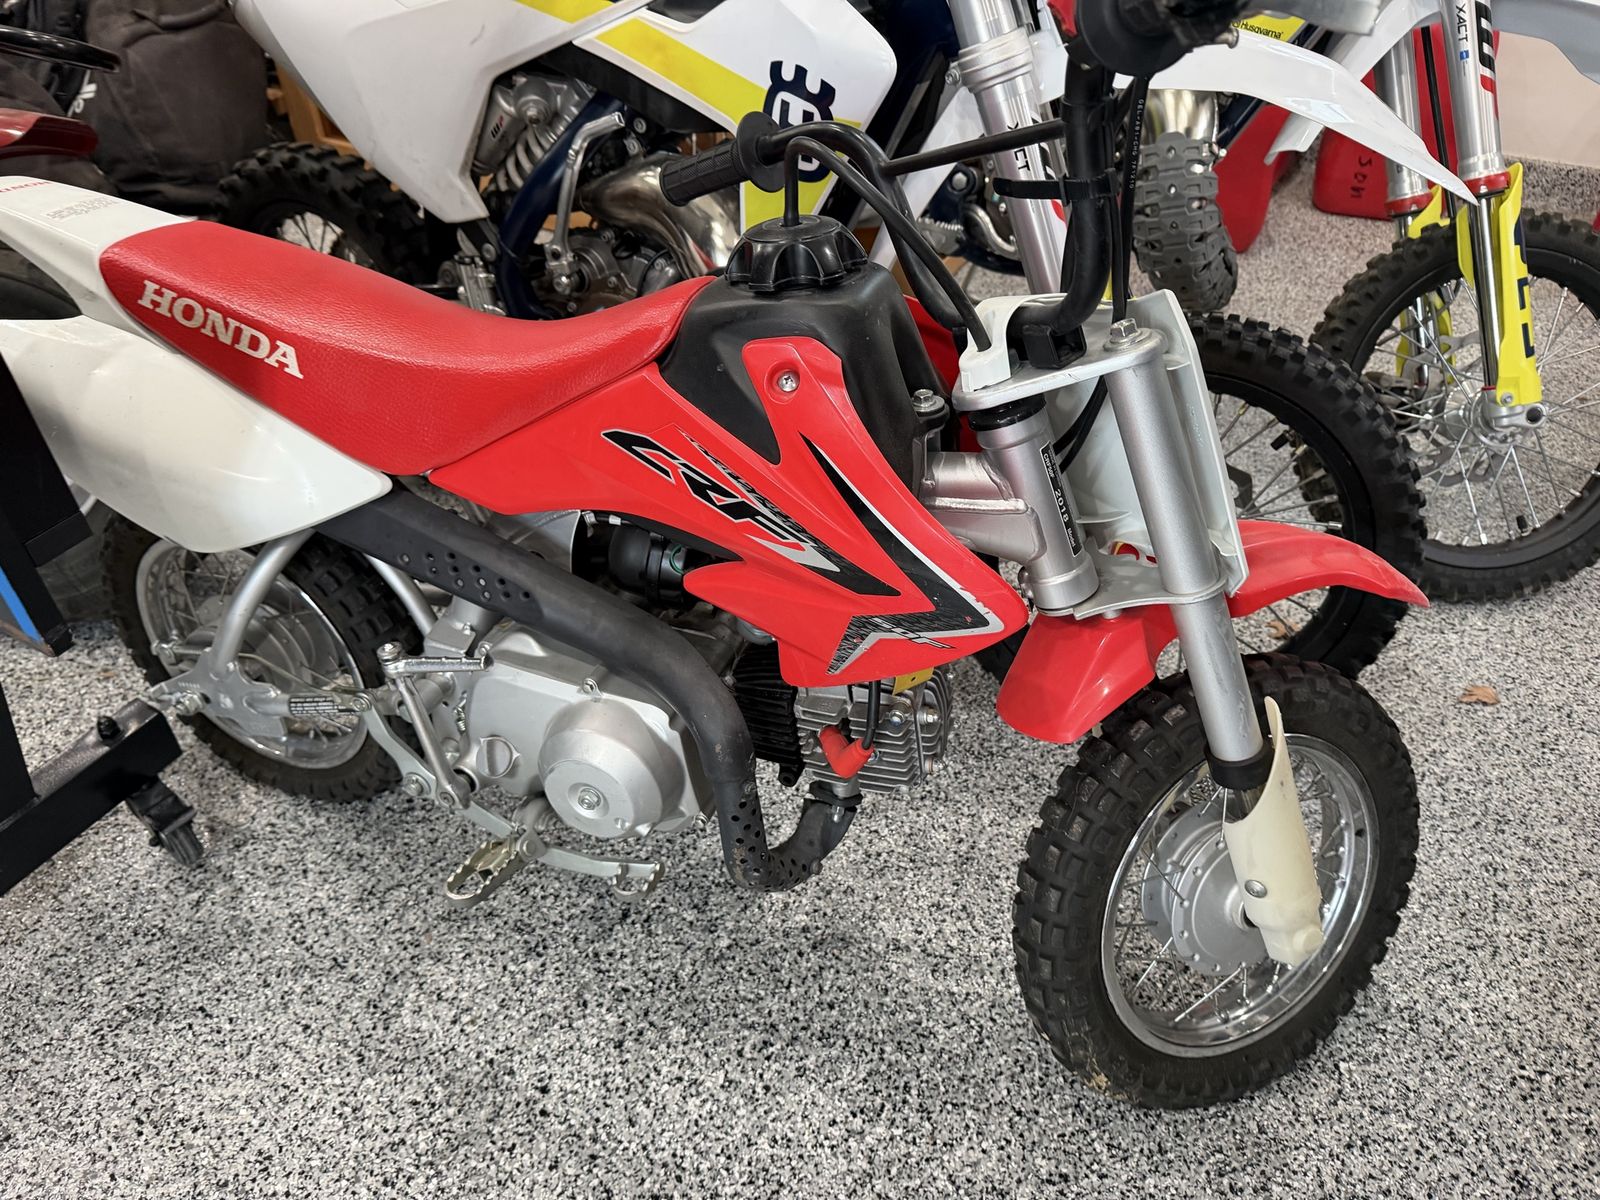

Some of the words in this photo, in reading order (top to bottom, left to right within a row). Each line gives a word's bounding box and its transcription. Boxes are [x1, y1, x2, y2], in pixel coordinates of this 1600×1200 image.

[1241, 21, 1282, 39] Husqvarna
[1456, 3, 1468, 42] XACT
[137, 279, 304, 379] HONDA
[600, 429, 818, 547] CRF
[1055, 488, 1069, 522] 2018
[1067, 527, 1076, 548] Model
